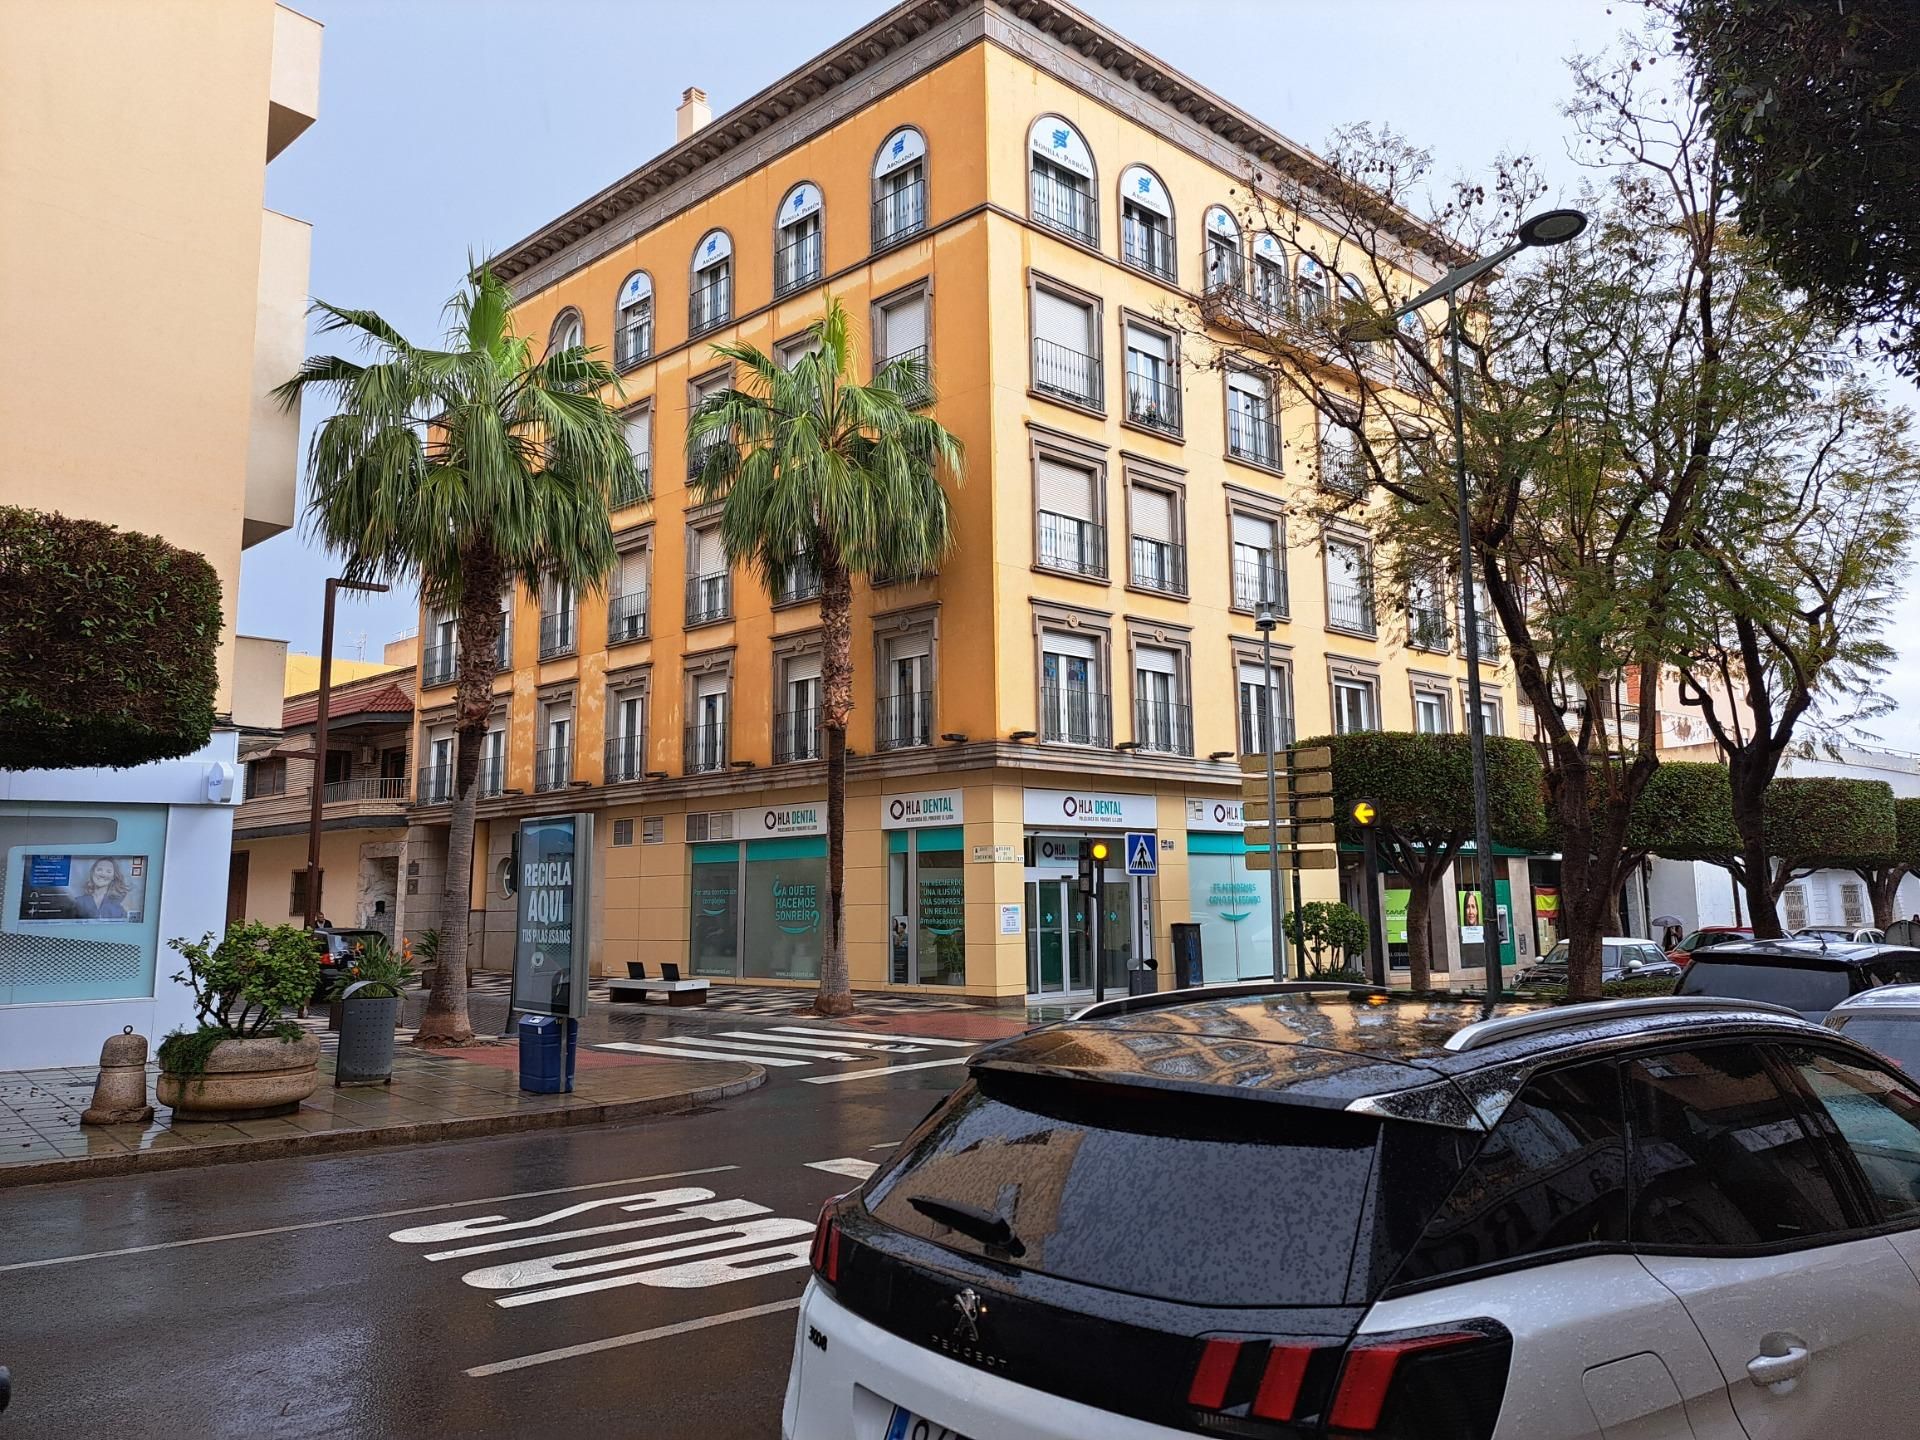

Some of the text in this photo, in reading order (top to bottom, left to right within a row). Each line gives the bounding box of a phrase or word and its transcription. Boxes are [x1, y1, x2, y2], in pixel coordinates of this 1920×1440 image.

[906, 797, 953, 815] HLA DENTAL
[1079, 800, 1122, 815] HLA DENTAL
[1227, 807, 1239, 820] HLA
[778, 809, 817, 826] HLA DENTAL
[1054, 843, 1066, 856] HLA
[524, 861, 572, 887] RECICLA
[806, 885, 817, 896] TE
[527, 889, 565, 926] AQUI
[775, 897, 816, 909] HACEMOS
[522, 928, 532, 943] TUS
[808, 1324, 828, 1353] 3008
[931, 1335, 1009, 1369] PEUGEOT
